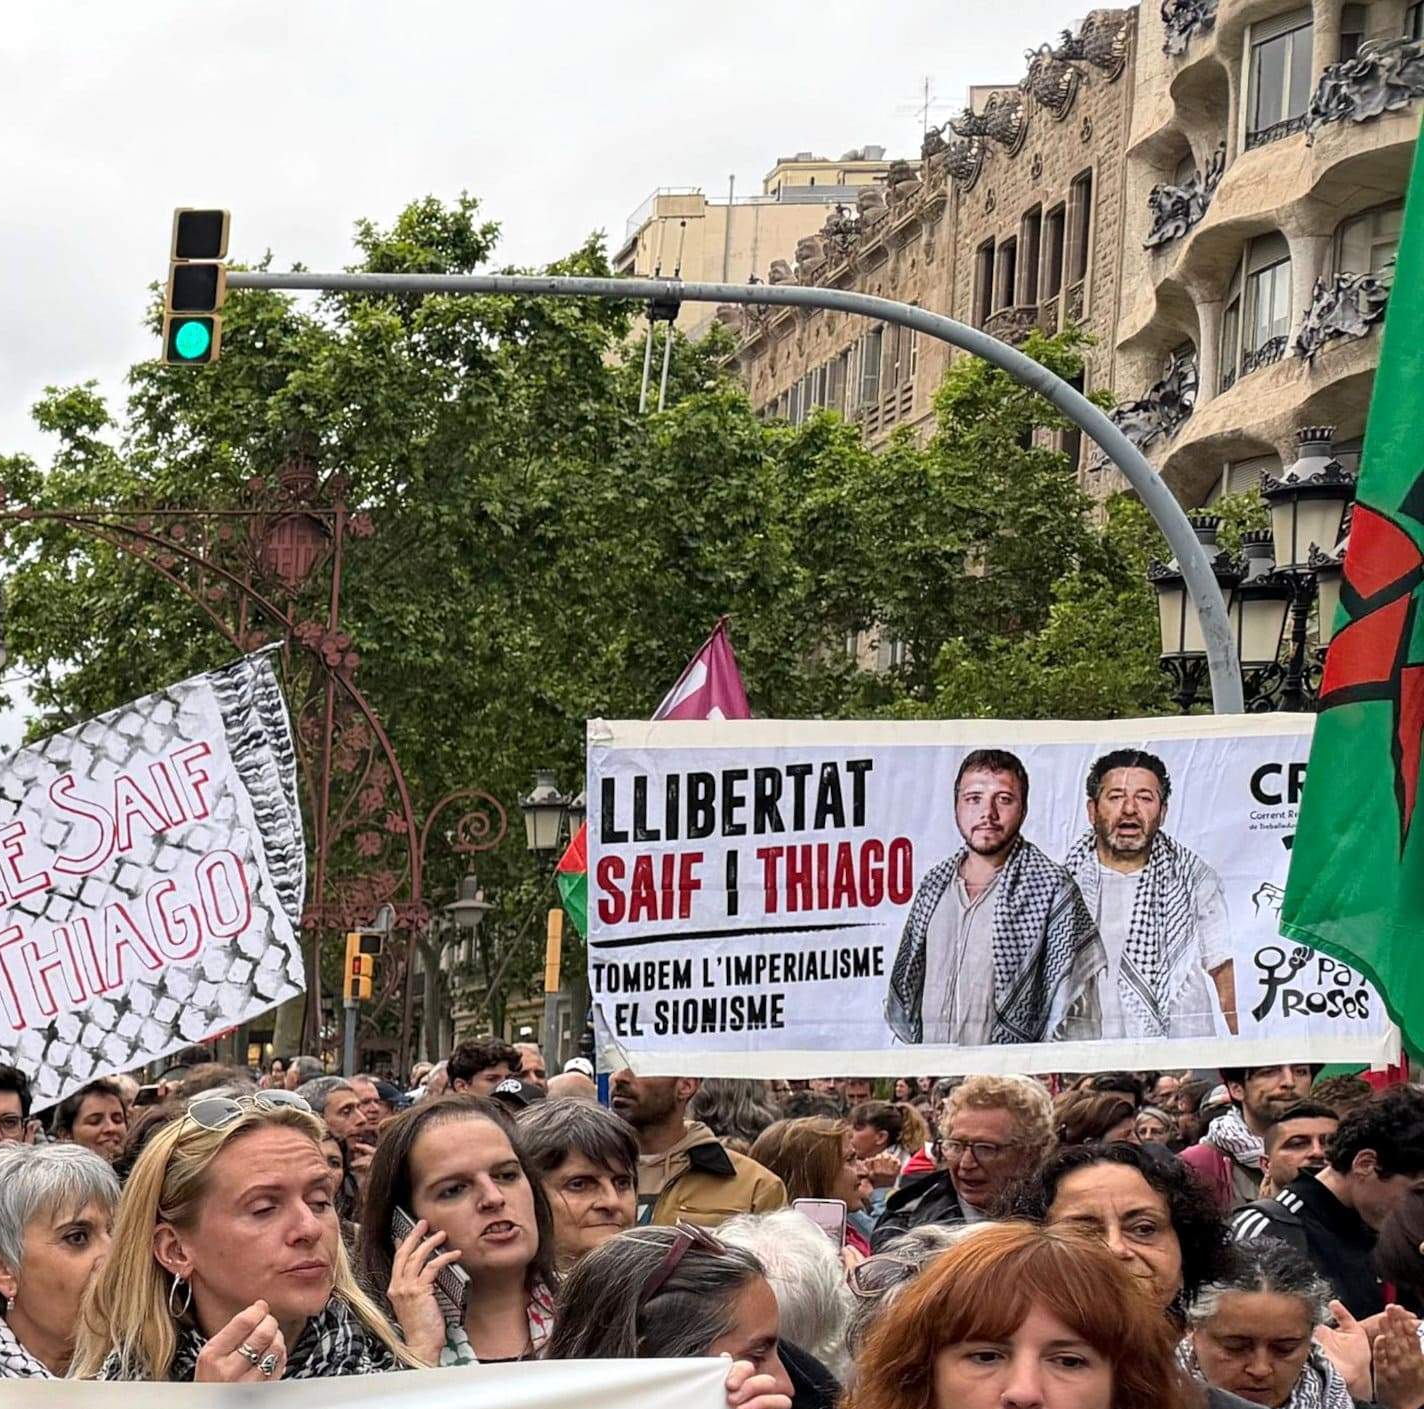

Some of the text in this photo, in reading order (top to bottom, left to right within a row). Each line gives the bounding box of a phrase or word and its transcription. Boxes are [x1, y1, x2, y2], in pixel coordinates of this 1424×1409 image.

[48, 741, 212, 876] SAIF
[600, 758, 873, 844] LLIBERTAT
[596, 836, 914, 925] SAIF I THIAGO
[592, 946, 884, 993] TOMBEM L'IMPERIALISME
[615, 993, 786, 1037] EL SIONISME
